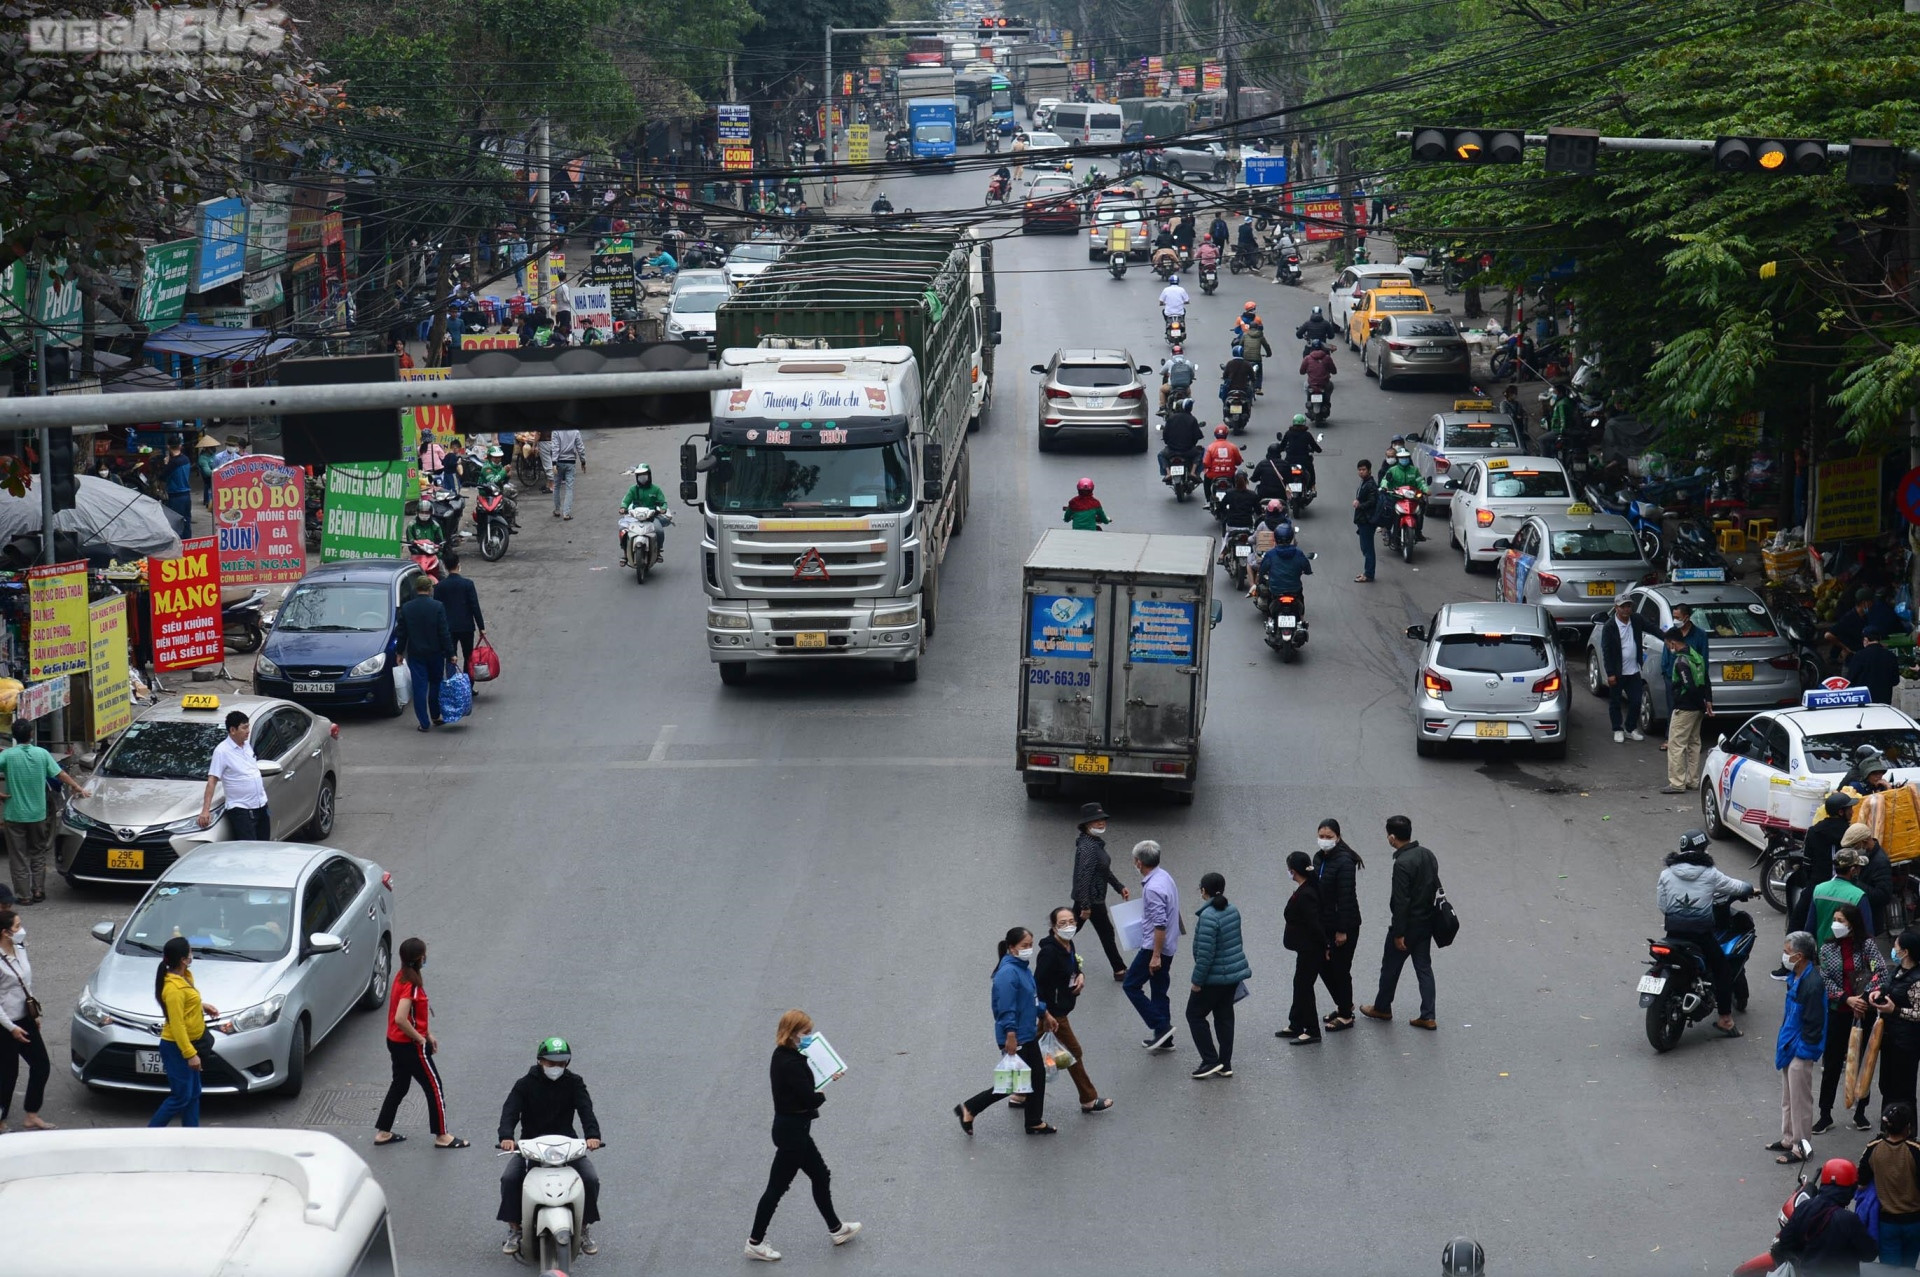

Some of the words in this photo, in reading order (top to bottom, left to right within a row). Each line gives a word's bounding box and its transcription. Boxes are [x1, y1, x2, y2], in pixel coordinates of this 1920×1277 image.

[574, 291, 587, 310] NHÀ
[588, 289, 606, 309] THUỐC
[762, 391, 798, 411] Thượng
[800, 391, 814, 411] Lộ
[818, 390, 842, 407] Bình
[844, 395, 861, 407] An
[330, 464, 365, 496] CHUYÊN
[384, 472, 403, 500] CHO
[218, 477, 263, 510] PHỞ
[269, 478, 300, 508] BÒ
[256, 509, 285, 522] MÓNG
[327, 504, 357, 541] BỆNH
[358, 508, 388, 541] NHÂN
[390, 515, 399, 541] K
[218, 522, 252, 551] BÚN
[272, 525, 288, 538] GÀ
[268, 544, 293, 557] MỌC
[161, 554, 209, 582] SIM
[221, 556, 256, 571] MIẾN
[261, 558, 300, 570] NGAN
[153, 583, 218, 618] MẠNG
[162, 621, 182, 634] SIÊU
[184, 616, 214, 630] KHỦNG
[156, 637, 171, 650] ĐIỆN
[172, 634, 190, 647] THOẠI
[160, 650, 177, 662] GIÁ
[180, 646, 203, 659] SIÊU
[206, 640, 219, 654] RẺ
[1030, 669, 1091, 687] 29C-663.39
[187, 696, 211, 704] TAXI
[1078, 764, 1105, 772] 663.39
[1085, 756, 1099, 764] 29C
[111, 859, 139, 868] 025.74
[118, 851, 134, 860] 29E
